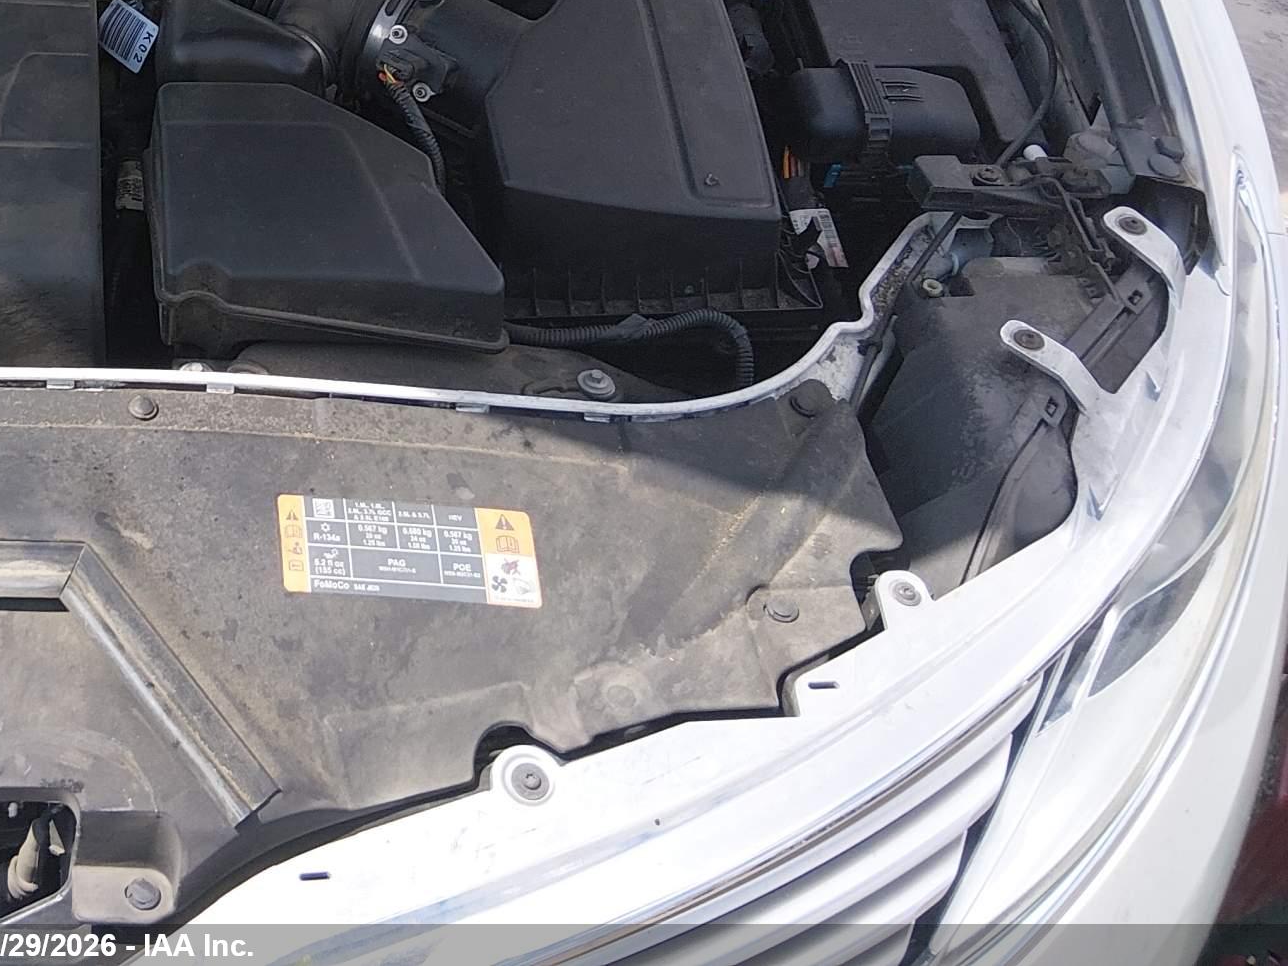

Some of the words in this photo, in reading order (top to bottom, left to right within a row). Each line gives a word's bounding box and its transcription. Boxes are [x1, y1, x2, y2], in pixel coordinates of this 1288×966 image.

[378, 525, 388, 534] kg
[422, 528, 432, 538] kg
[313, 532, 341, 542] R-134a
[463, 531, 473, 541] kg
[387, 558, 406, 566] PAG
[453, 563, 471, 572] POE
[314, 579, 350, 590] FoMoCo
